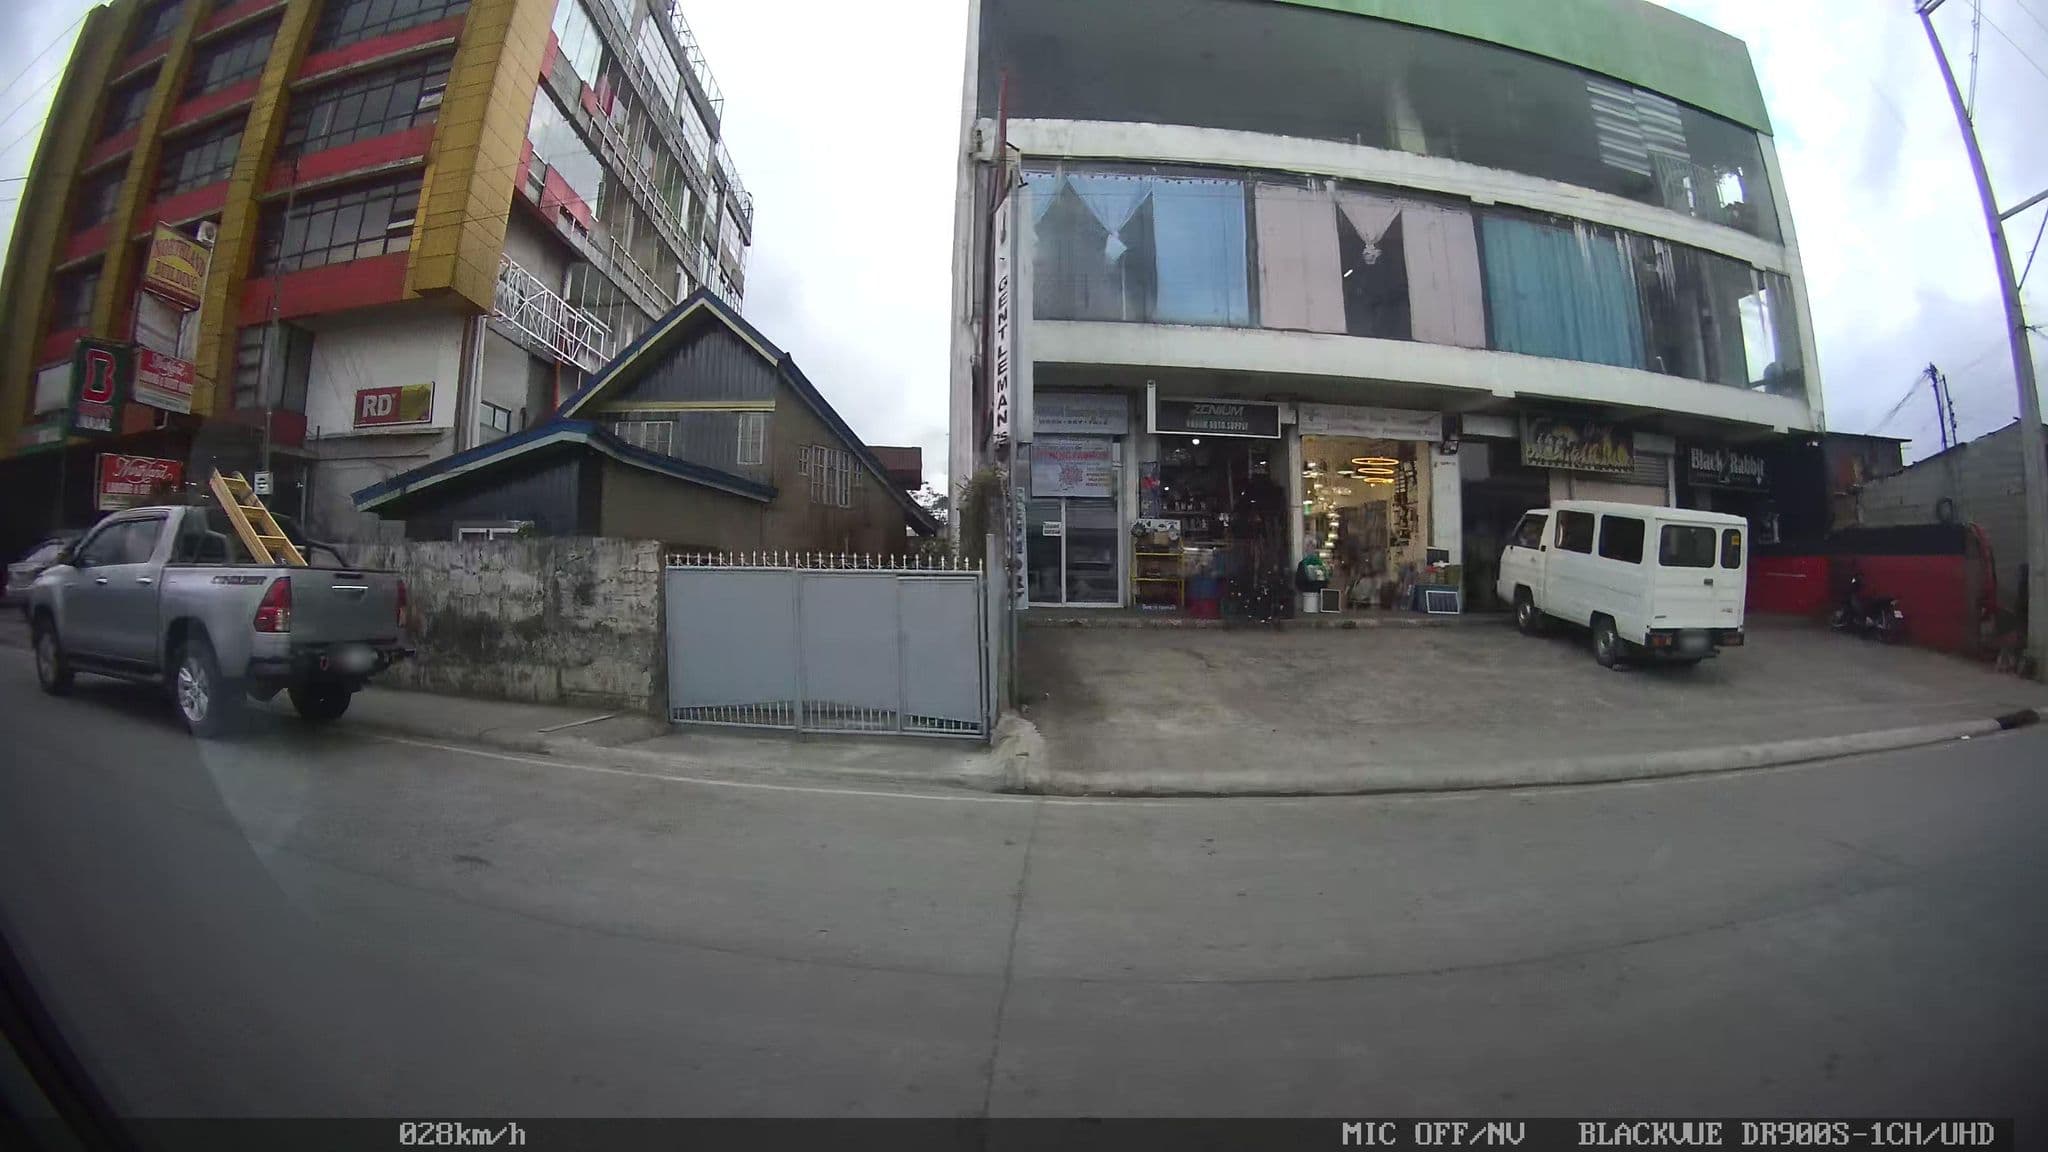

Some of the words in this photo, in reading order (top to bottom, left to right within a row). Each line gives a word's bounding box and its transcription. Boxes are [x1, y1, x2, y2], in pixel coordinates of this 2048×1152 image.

[362, 393, 394, 418] RD
[1690, 447, 1723, 472] Black
[1729, 451, 1765, 482] Rabbit
